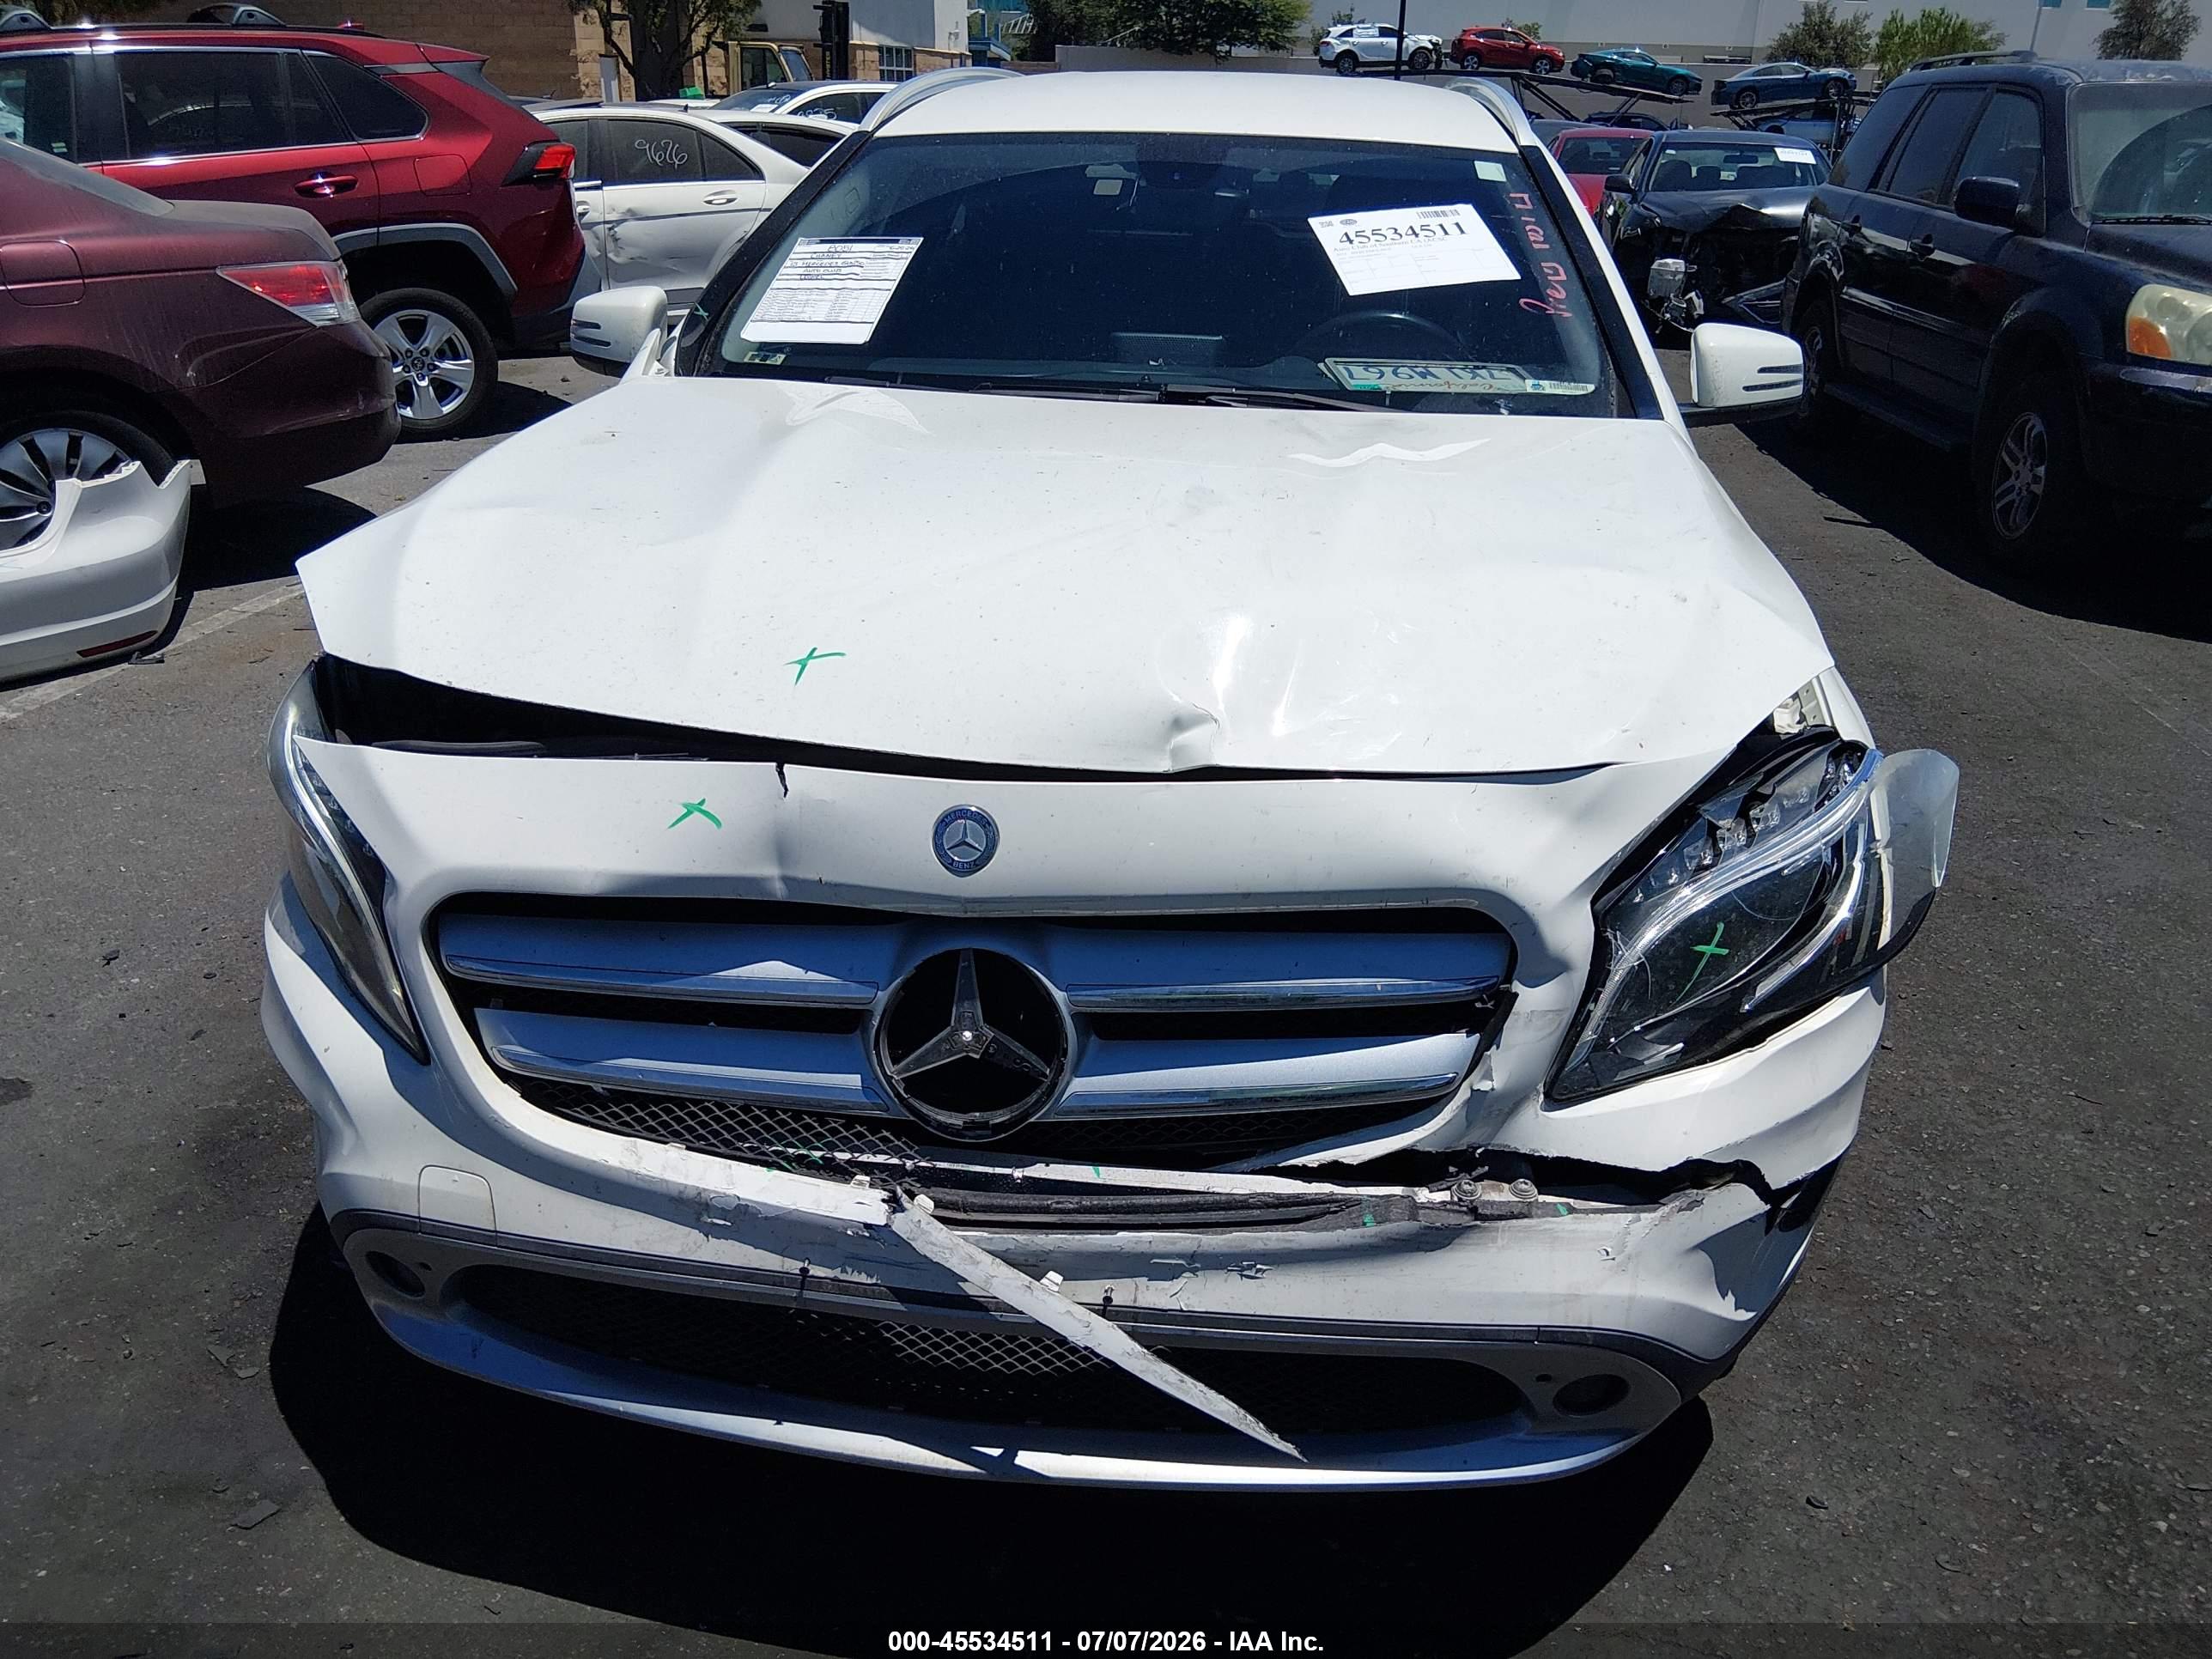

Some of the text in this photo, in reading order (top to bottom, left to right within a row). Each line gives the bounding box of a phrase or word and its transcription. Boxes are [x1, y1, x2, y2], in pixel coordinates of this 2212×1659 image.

[1339, 222, 1466, 245] 45534511
[944, 810, 986, 825] MERCEDES
[952, 860, 975, 869] BENZ
